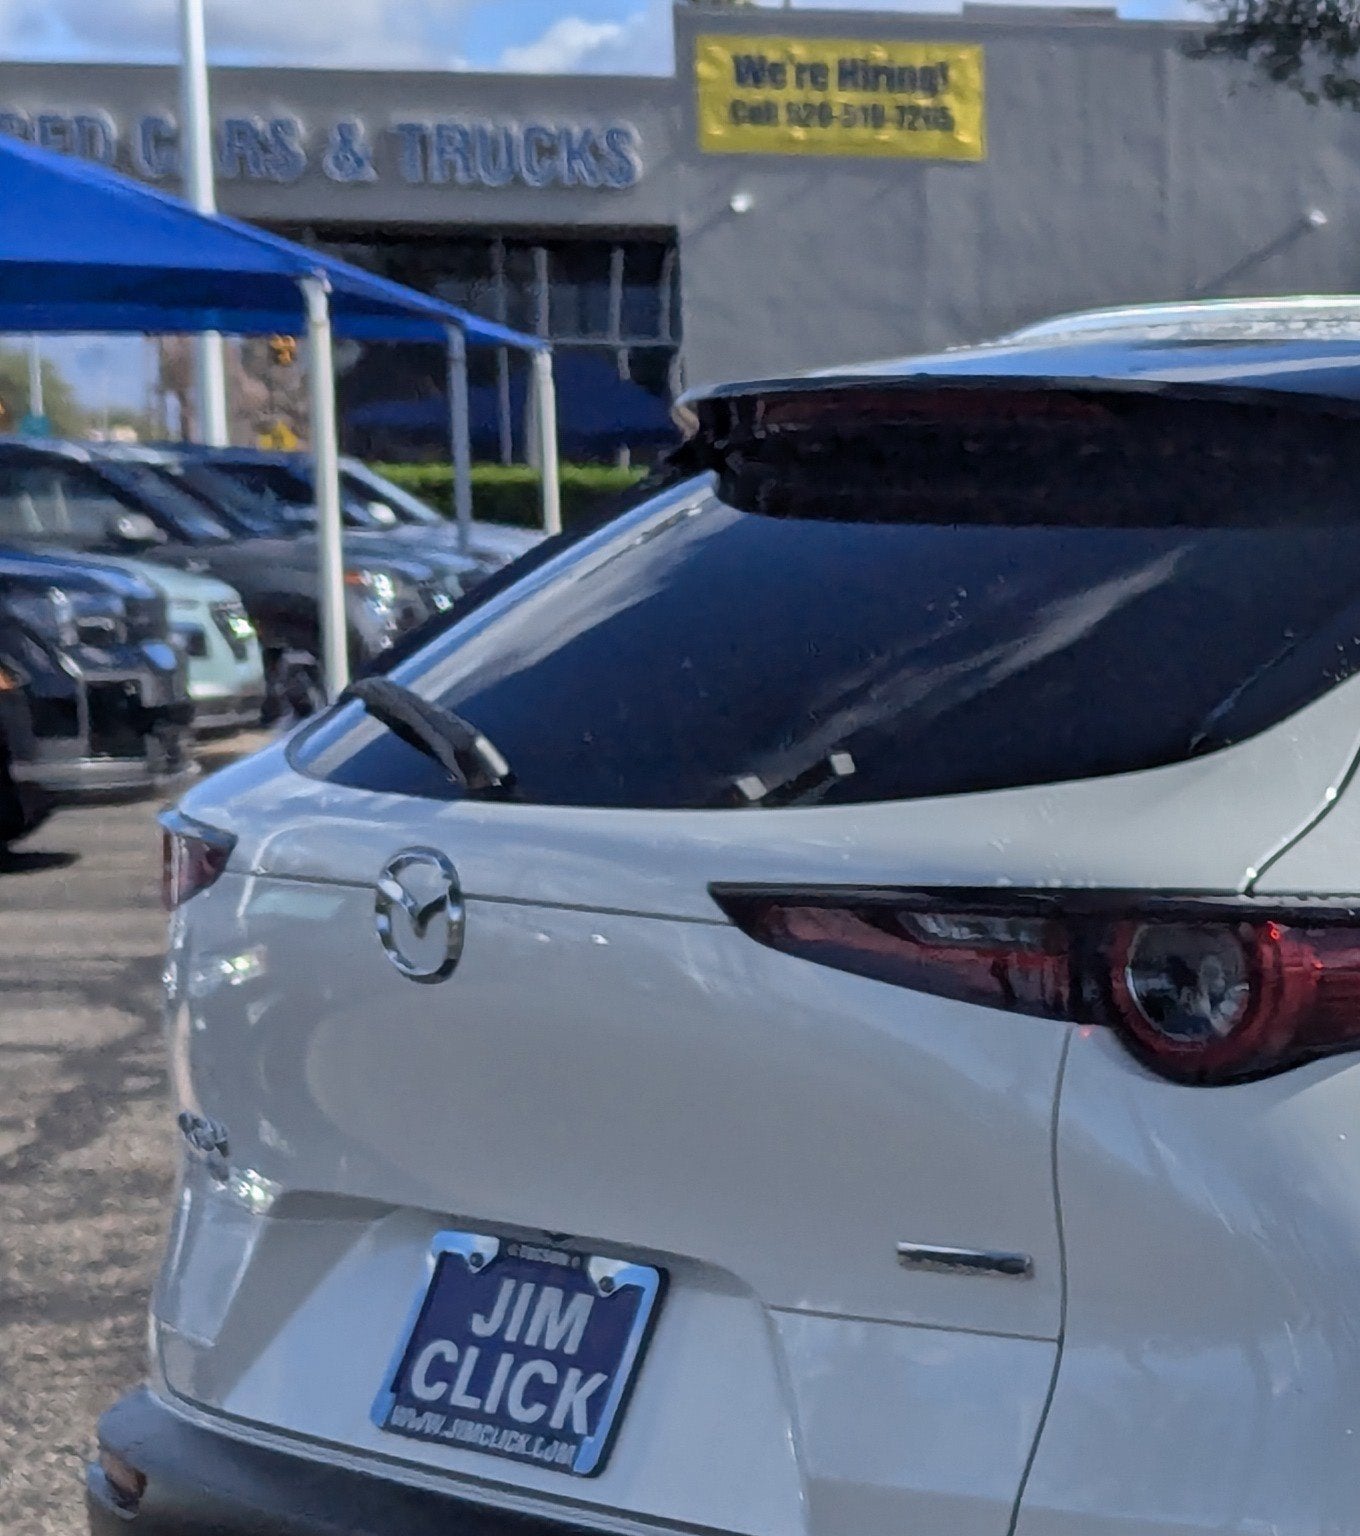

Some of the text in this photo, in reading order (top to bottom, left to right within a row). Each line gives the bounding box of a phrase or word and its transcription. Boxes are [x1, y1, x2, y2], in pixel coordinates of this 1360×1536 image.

[729, 98, 779, 127] Call
[732, 54, 949, 99] We're Hiring!
[136, 110, 307, 182] CRS
[323, 116, 378, 183] &
[391, 113, 643, 188] TRUCKS
[470, 1278, 595, 1355] JIM
[410, 1339, 609, 1435] CLICK
